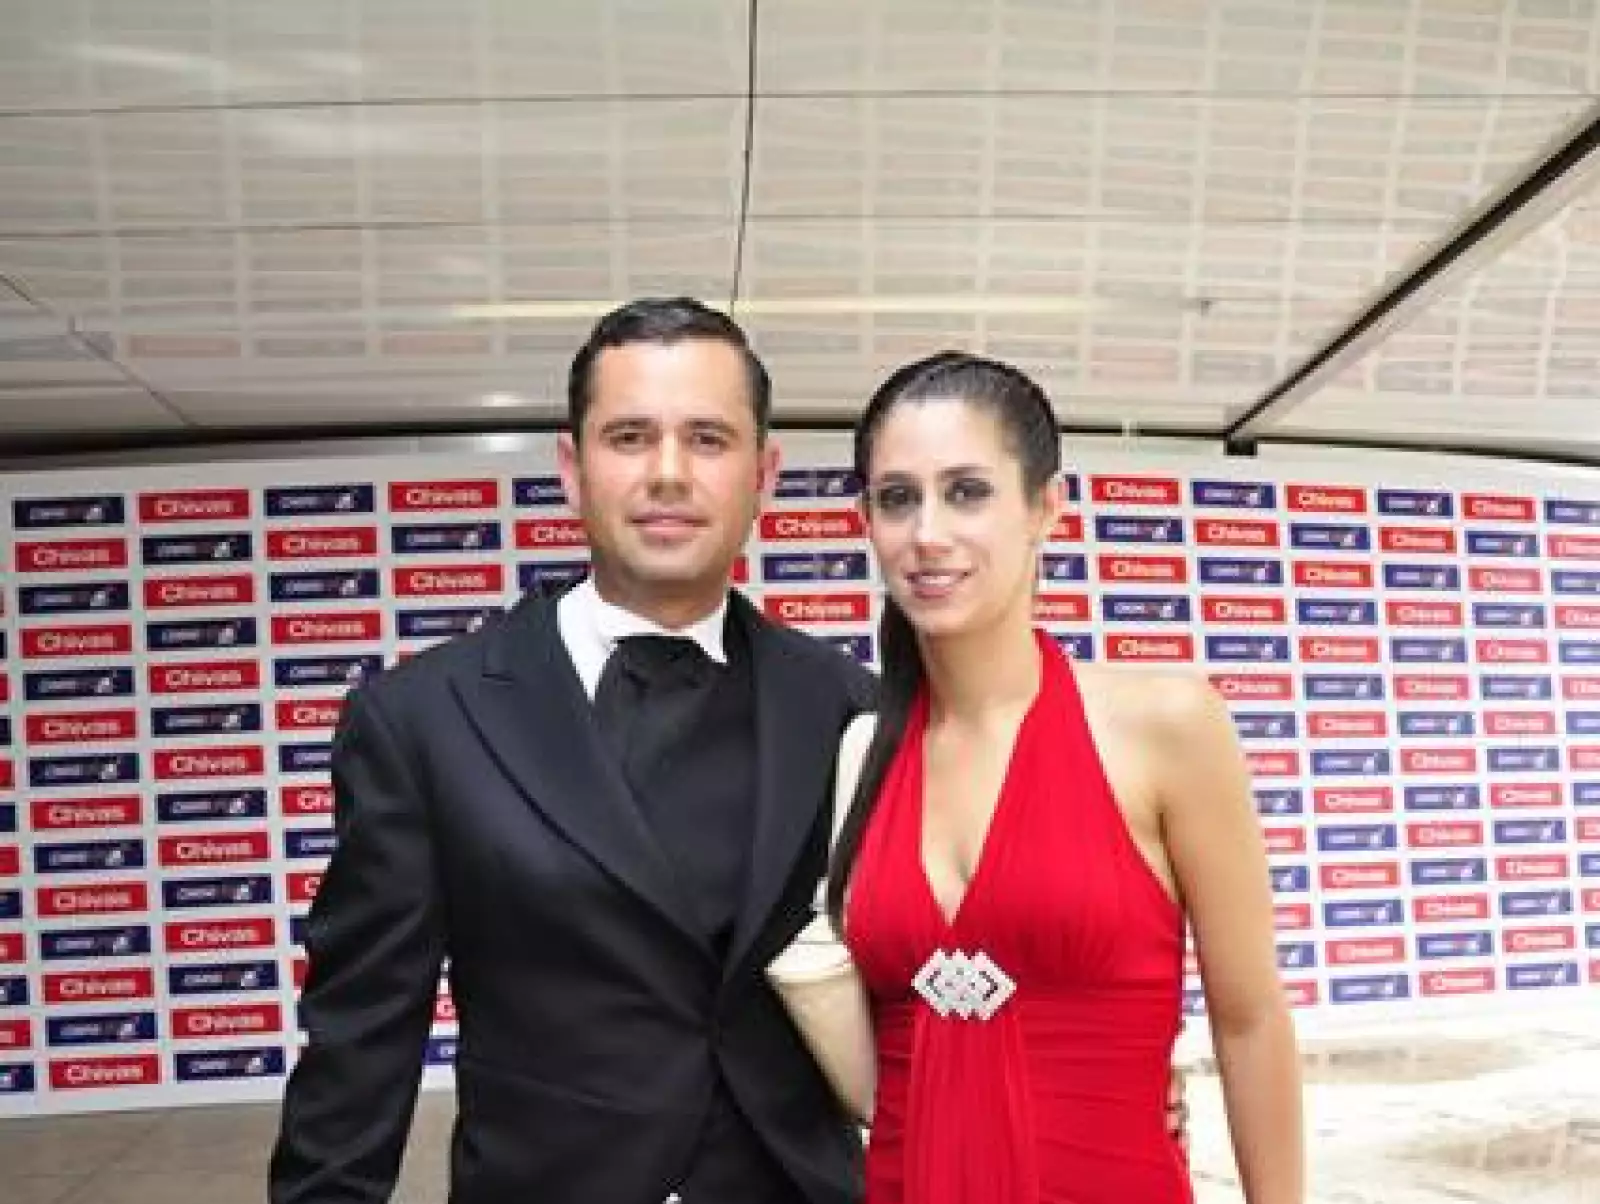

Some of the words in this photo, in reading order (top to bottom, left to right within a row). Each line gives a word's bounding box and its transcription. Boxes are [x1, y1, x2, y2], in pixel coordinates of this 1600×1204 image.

[156, 497, 232, 515] Chivas
[406, 489, 482, 505] Chivas
[283, 537, 359, 551] Chivas
[33, 549, 109, 564] Chivas
[410, 573, 486, 588] Chivas
[161, 582, 237, 603] Chivas
[289, 618, 364, 637] Chivas
[38, 631, 114, 649] Chivas
[167, 668, 241, 685] Chivas
[43, 718, 119, 738] Chivas
[170, 754, 246, 771] Chivas
[49, 803, 124, 821] Chivas
[176, 837, 251, 858] Chivas
[53, 889, 130, 908] Chivas
[181, 929, 258, 947] Chivas
[60, 976, 136, 997] Chivas
[188, 1011, 264, 1031] Chivas
[66, 1060, 143, 1080] Chivas
